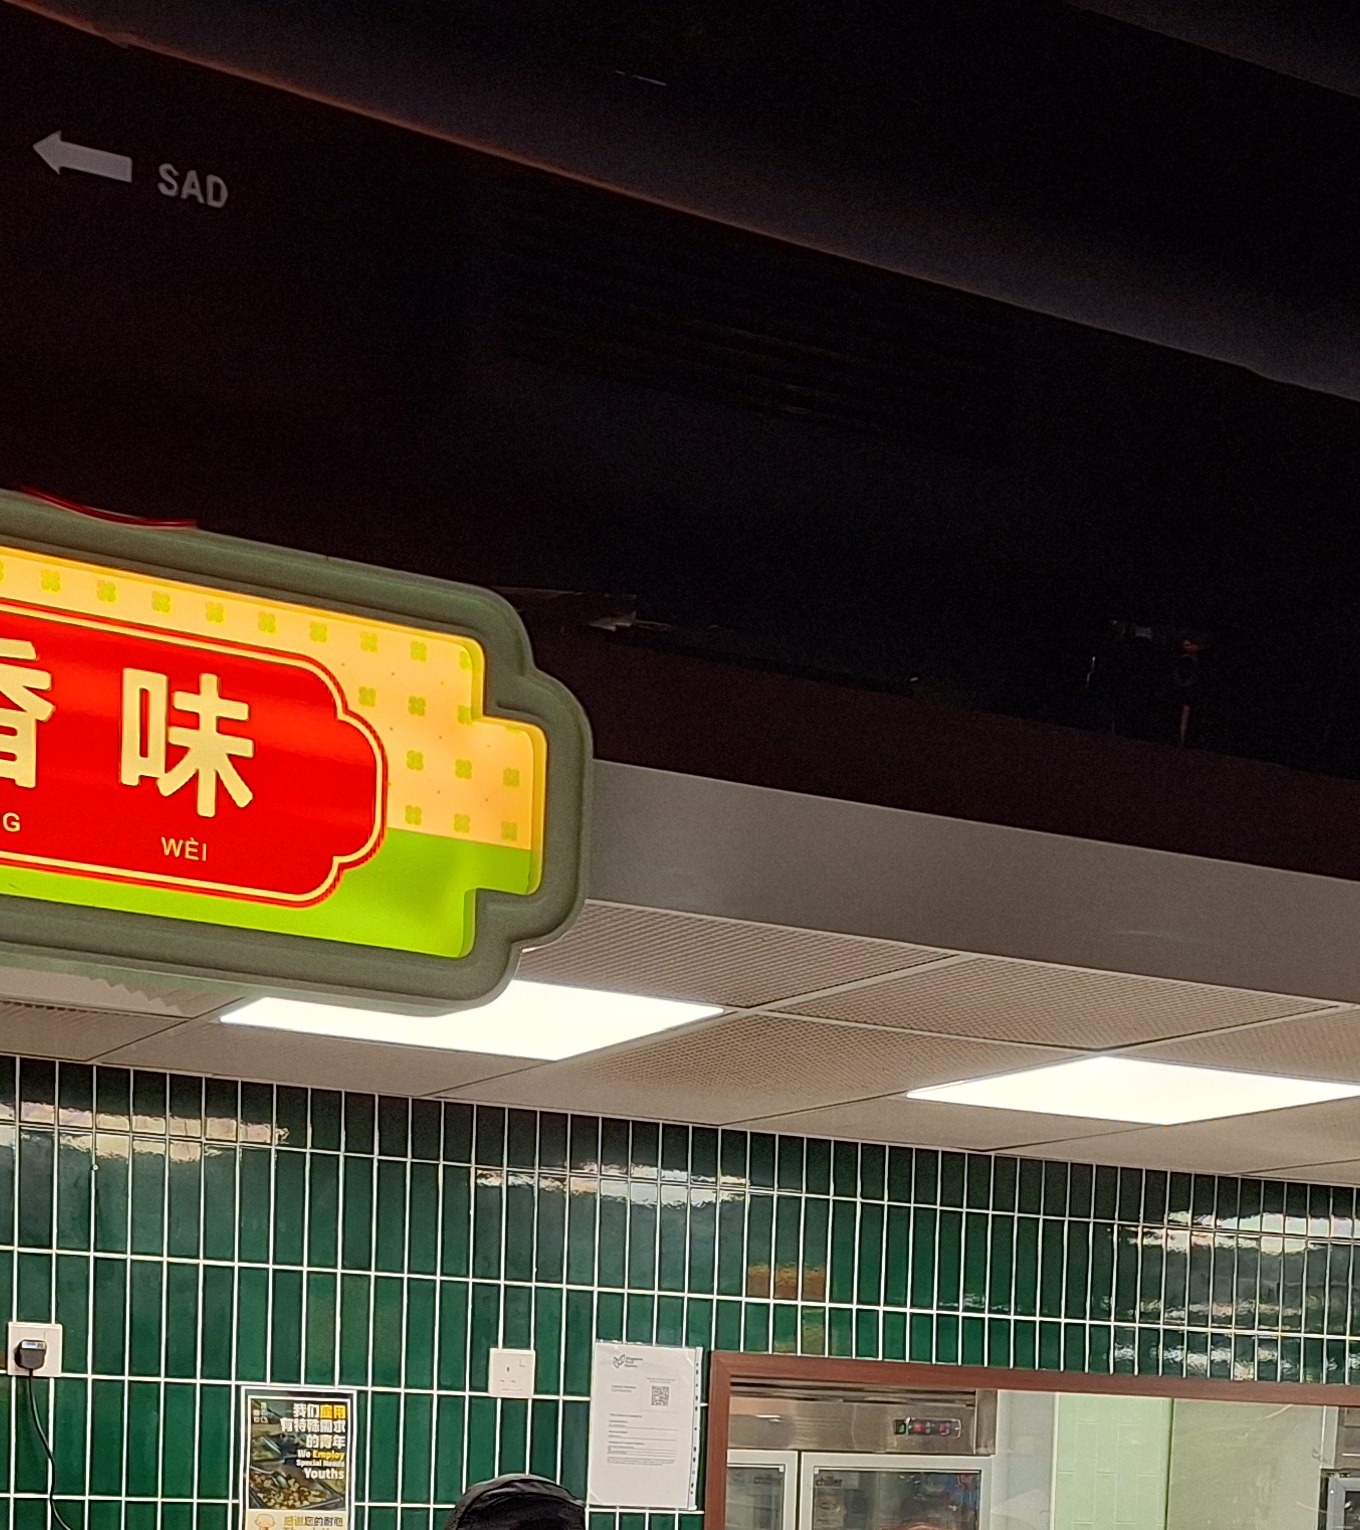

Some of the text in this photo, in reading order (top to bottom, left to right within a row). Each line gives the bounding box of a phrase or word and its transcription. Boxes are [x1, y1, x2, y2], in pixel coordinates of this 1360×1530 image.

[157, 162, 228, 209] SAD
[161, 836, 207, 862] WÈI
[304, 1468, 345, 1479] Youths
